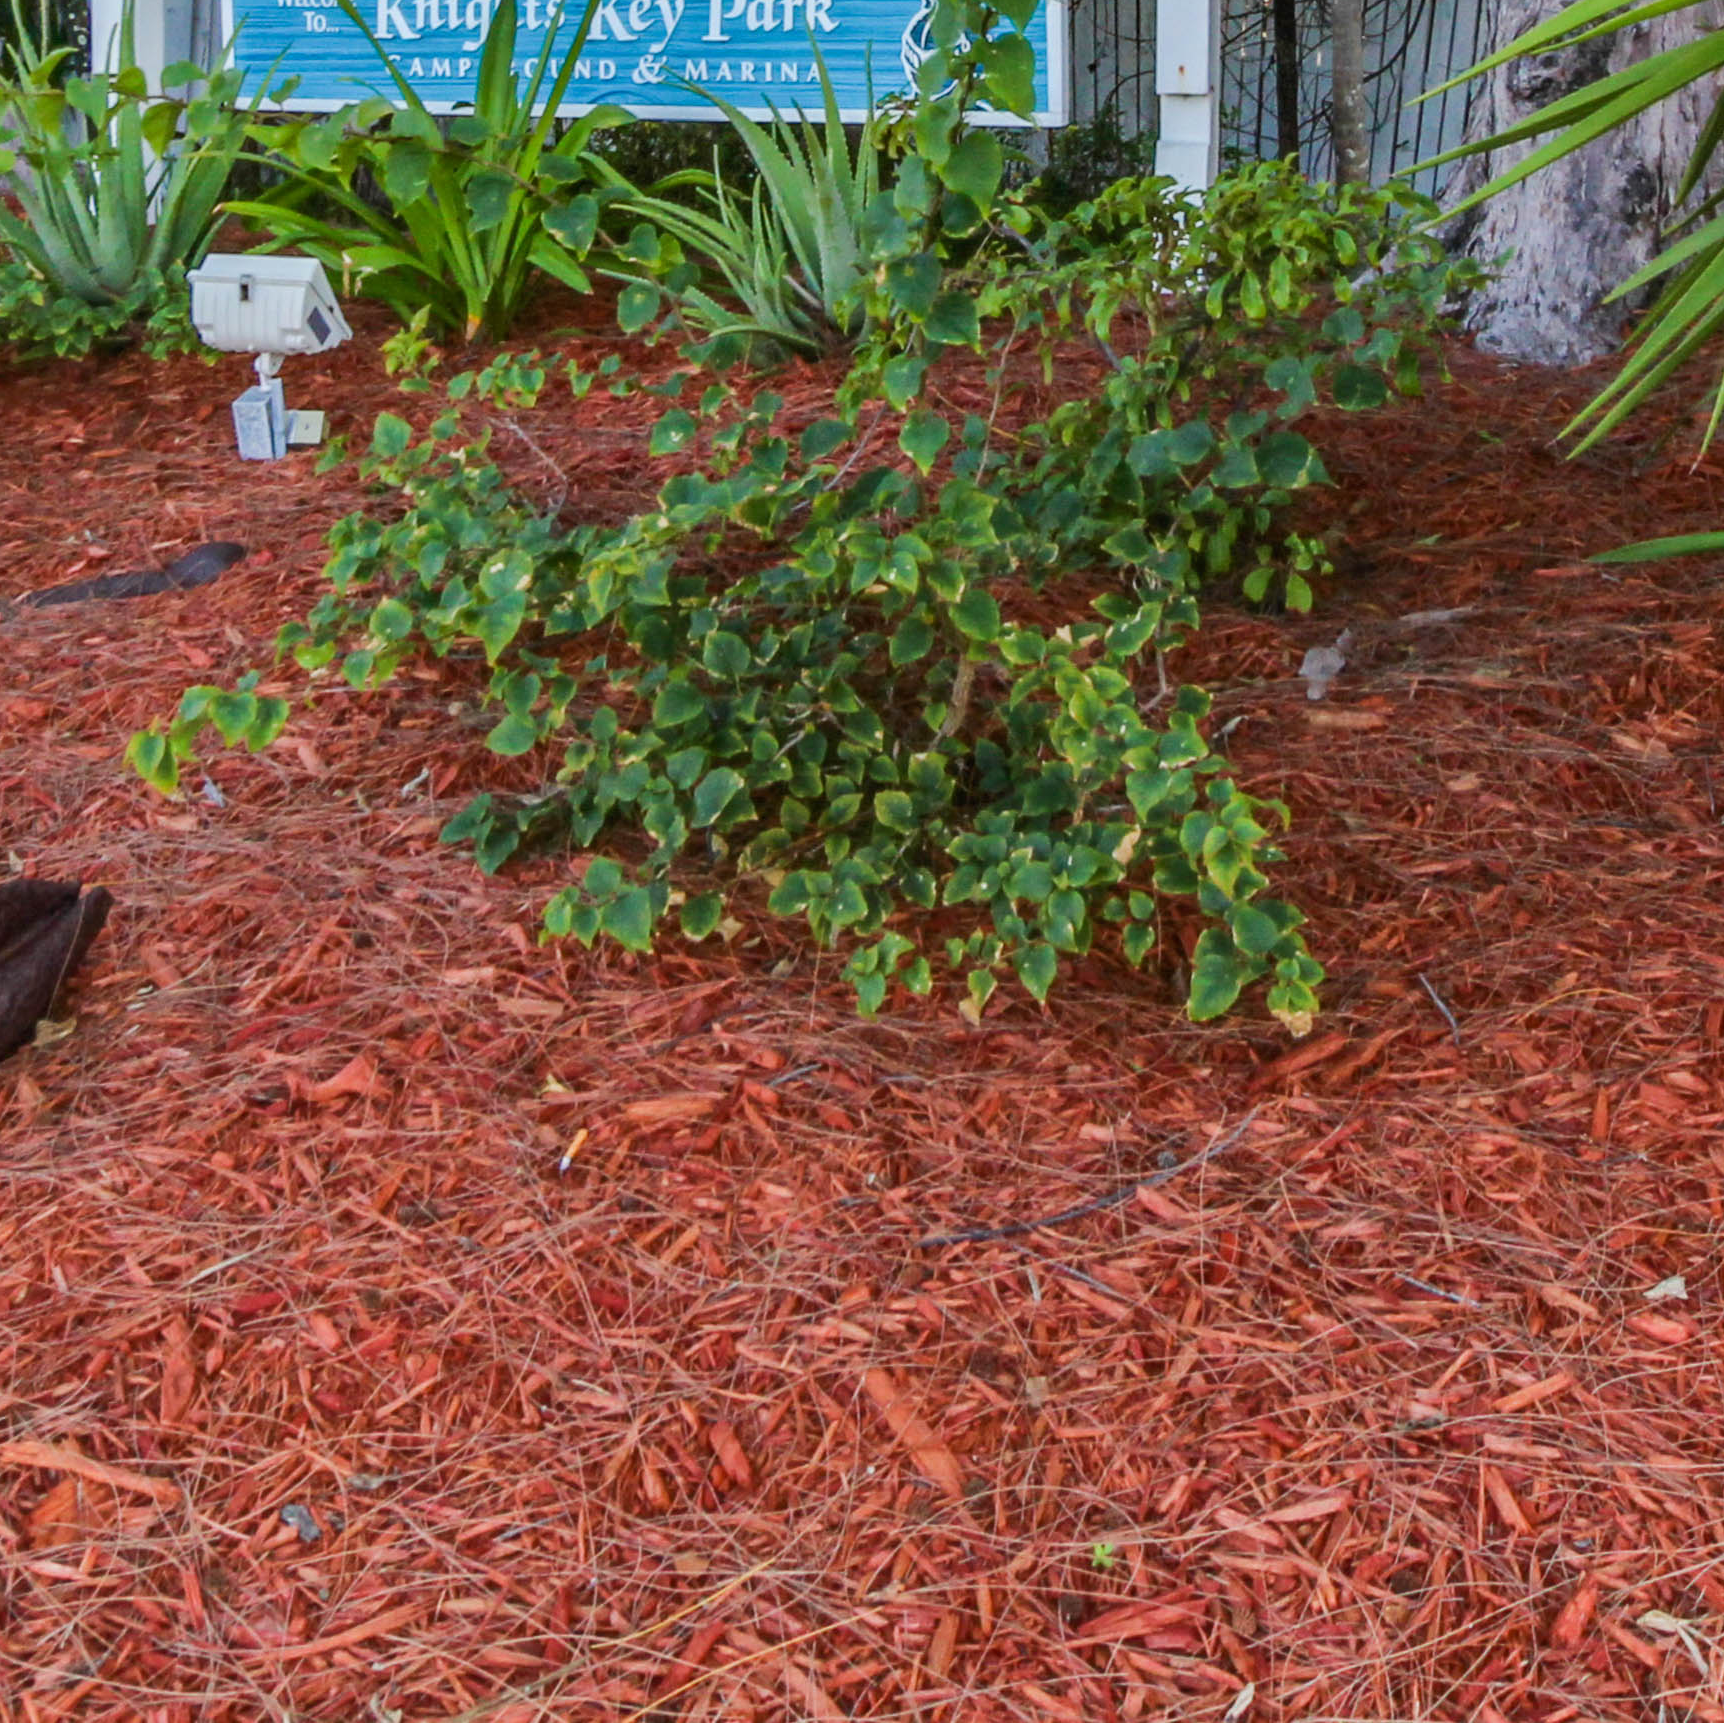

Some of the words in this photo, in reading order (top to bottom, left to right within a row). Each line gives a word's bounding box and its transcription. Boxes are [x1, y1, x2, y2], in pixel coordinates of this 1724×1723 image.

[385, 54, 616, 80] AMPOUND
[632, 54, 667, 84] &
[685, 59, 823, 82] MARINA
